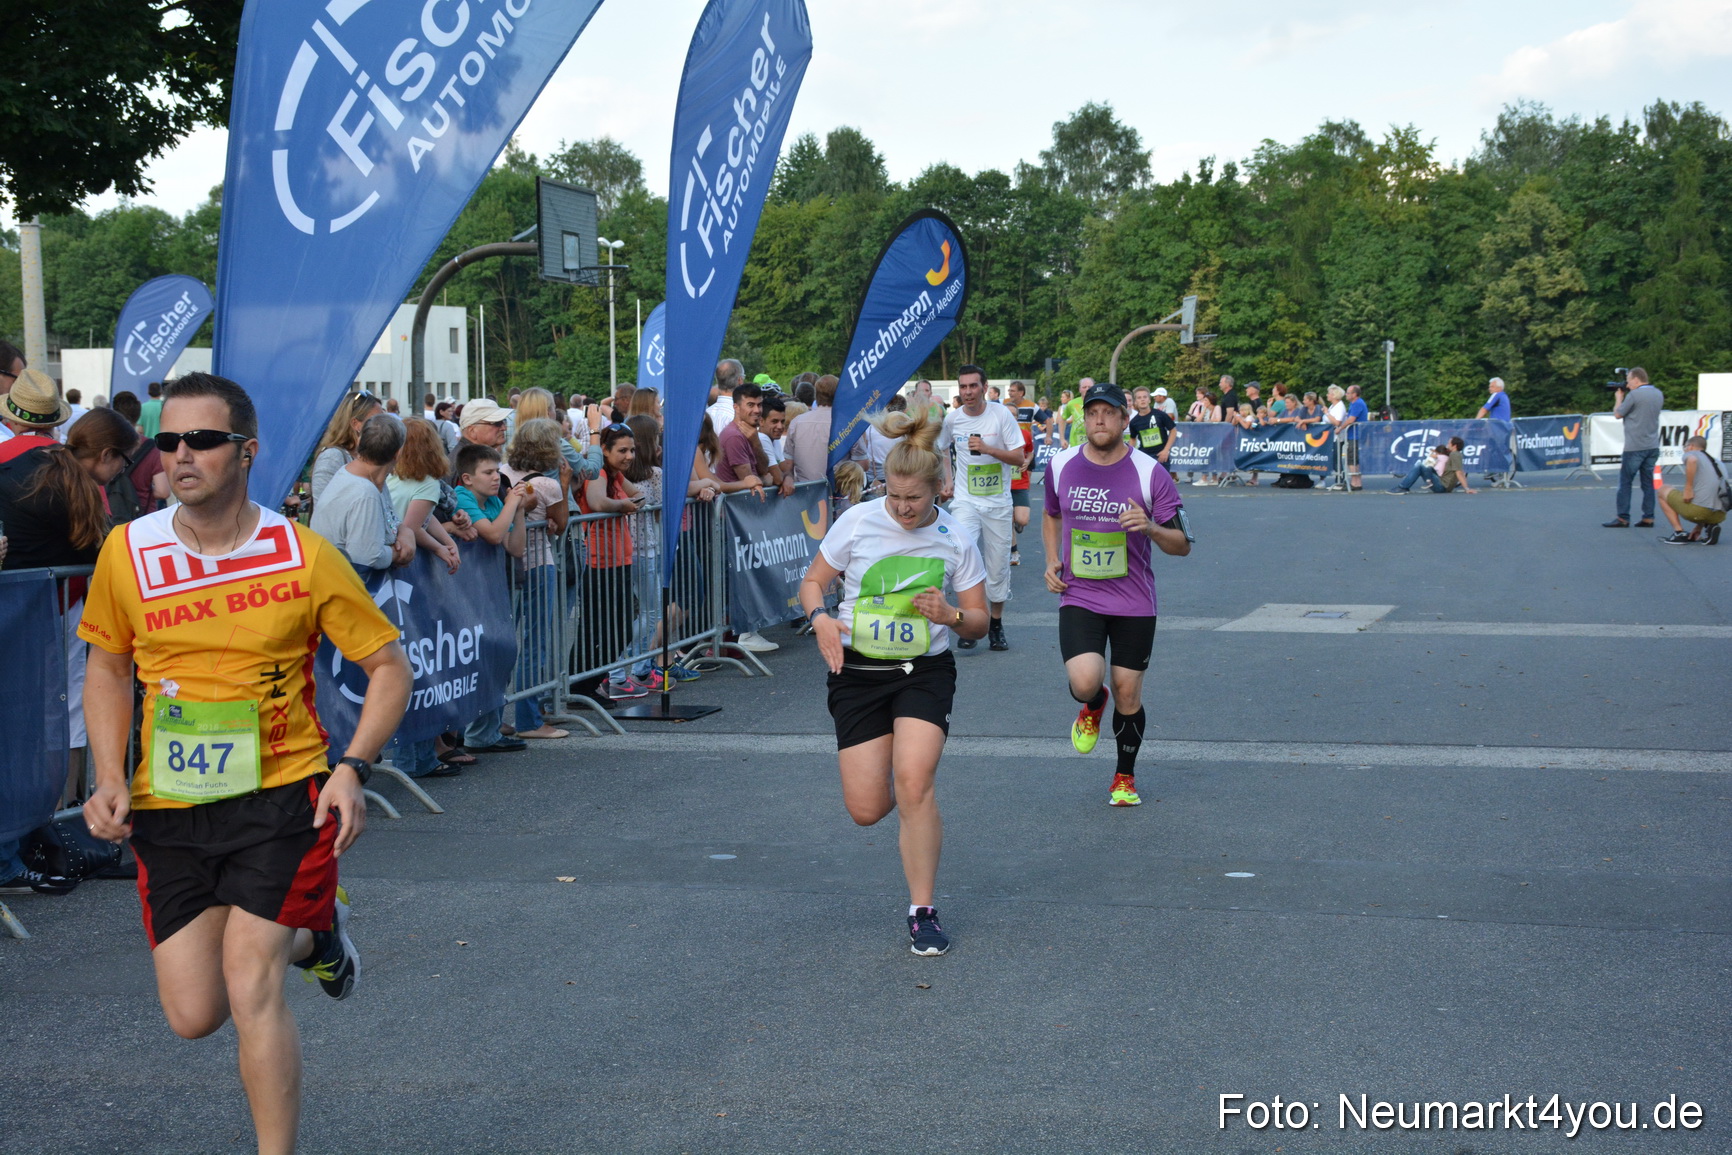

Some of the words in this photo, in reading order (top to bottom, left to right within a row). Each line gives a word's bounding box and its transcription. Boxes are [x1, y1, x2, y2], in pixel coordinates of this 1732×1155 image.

[326, 0, 484, 177] Fisc
[697, 11, 775, 259] Fischer
[722, 55, 787, 255] AUTOMOBILE
[137, 290, 192, 363] Fischer
[902, 321, 923, 349] Druck
[936, 279, 962, 314] Medien
[156, 304, 199, 362] AUTOMOBILE
[847, 290, 932, 389] Frischmann
[1239, 437, 1306, 452] Frischmann
[1276, 452, 1294, 460] Druck
[1516, 433, 1565, 450] Frischmann
[971, 475, 999, 487] 1322
[1067, 486, 1110, 500] HECK
[1070, 499, 1132, 514] DESIGN
[734, 530, 809, 572] Frischmann
[1082, 550, 1115, 566] 517
[144, 598, 217, 632] MAX
[226, 580, 310, 614] BÖGL
[869, 619, 914, 643] 118
[168, 740, 234, 775] 847
[204, 781, 228, 789] Fuchs
